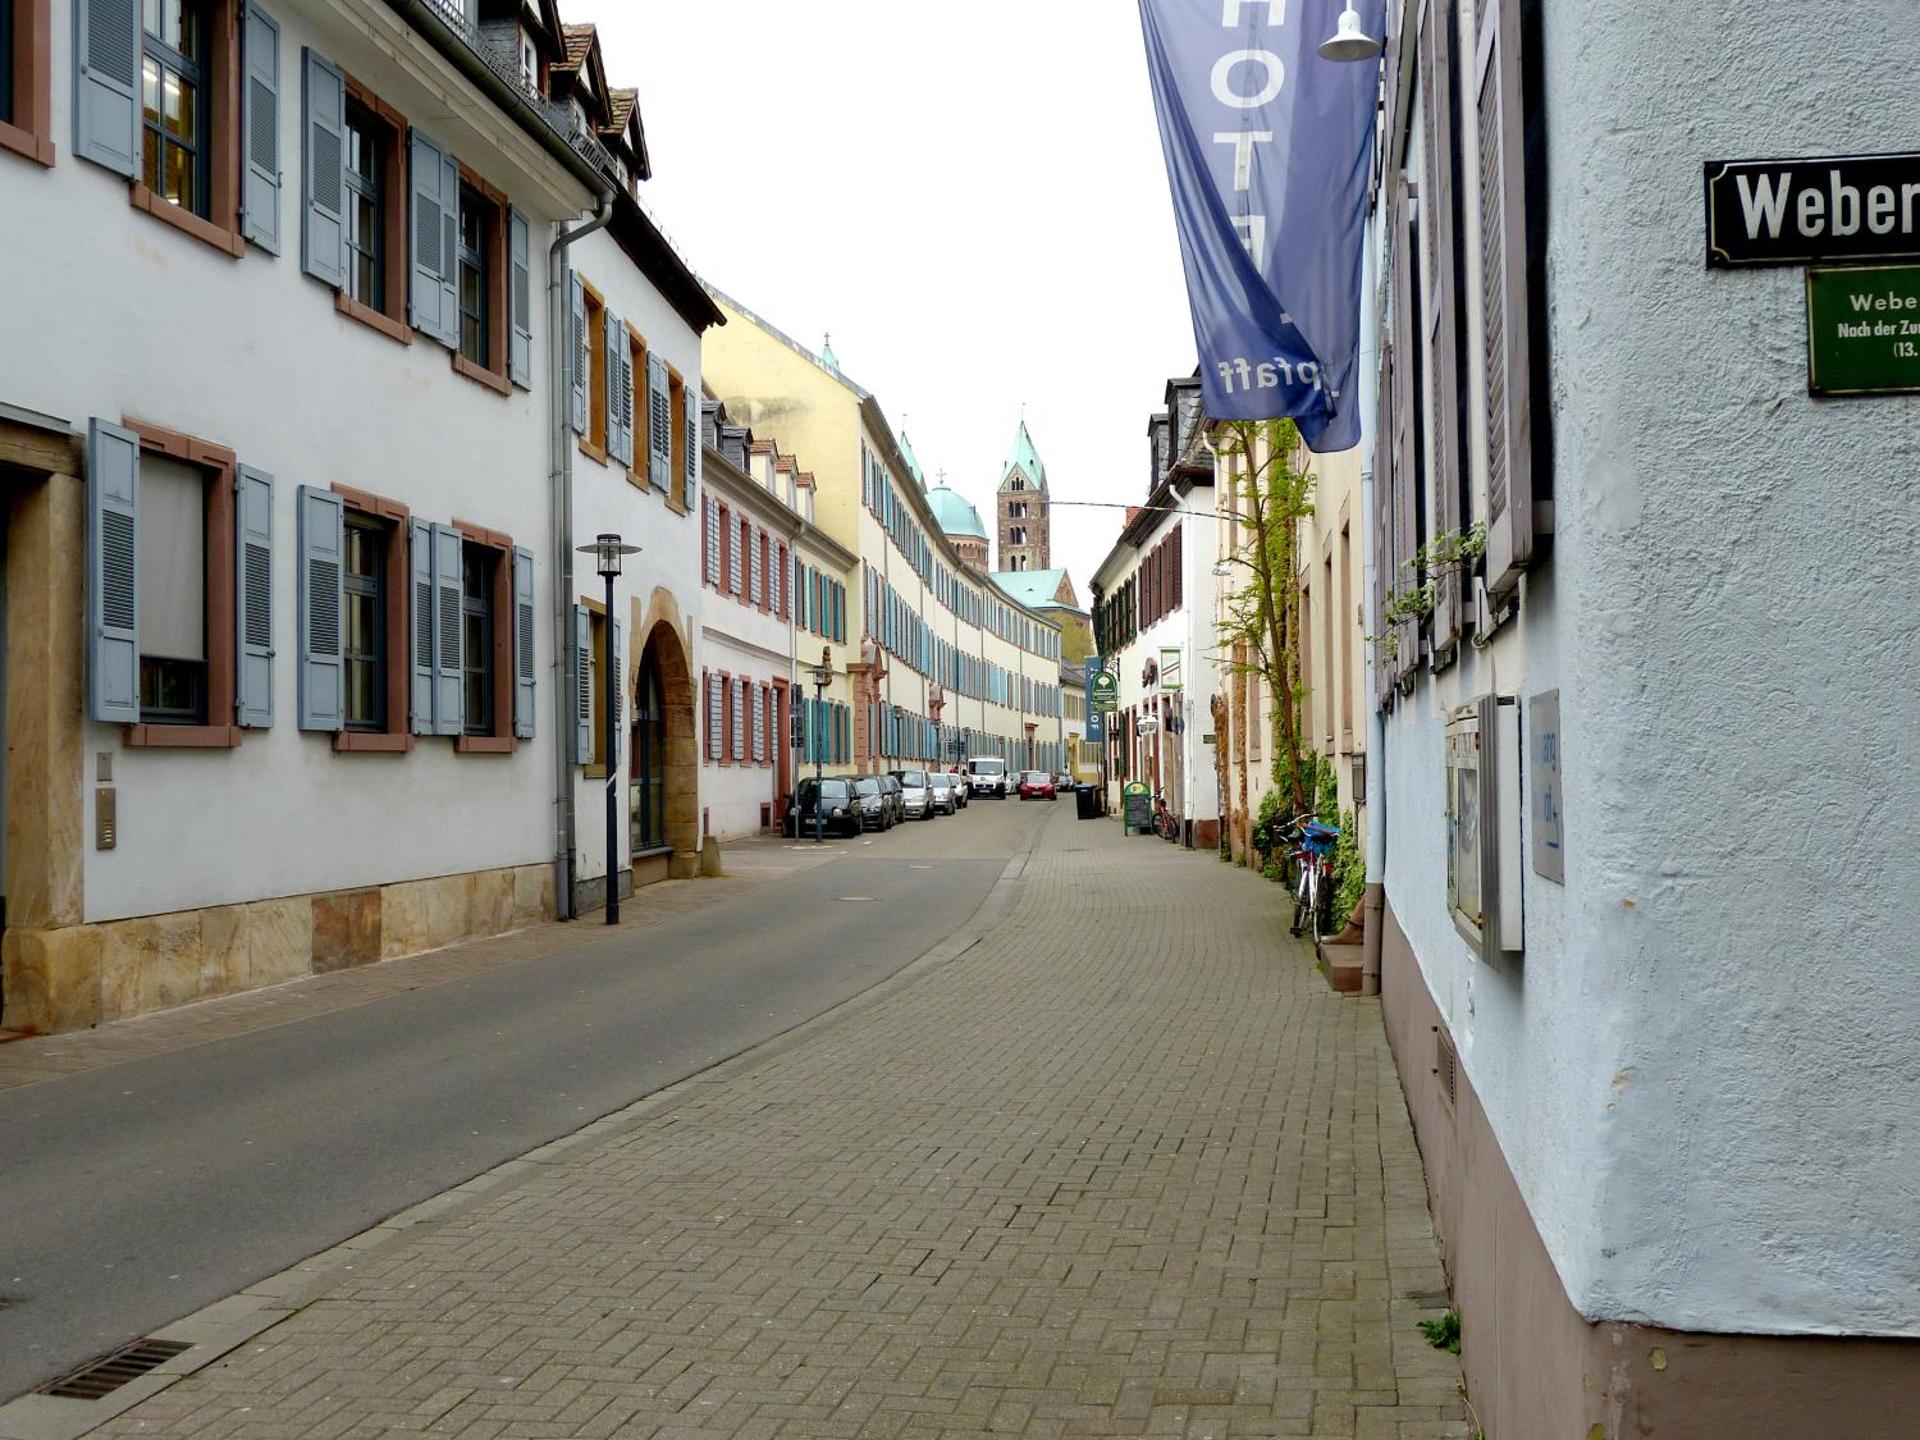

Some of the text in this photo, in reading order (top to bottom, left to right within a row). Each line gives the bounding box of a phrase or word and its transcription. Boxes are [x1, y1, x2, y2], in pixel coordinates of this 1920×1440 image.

[1849, 291, 1918, 312] Webe
[1838, 320, 1871, 338] Nach
[1874, 320, 1897, 335] der
[1893, 341, 1918, 358] (13.
